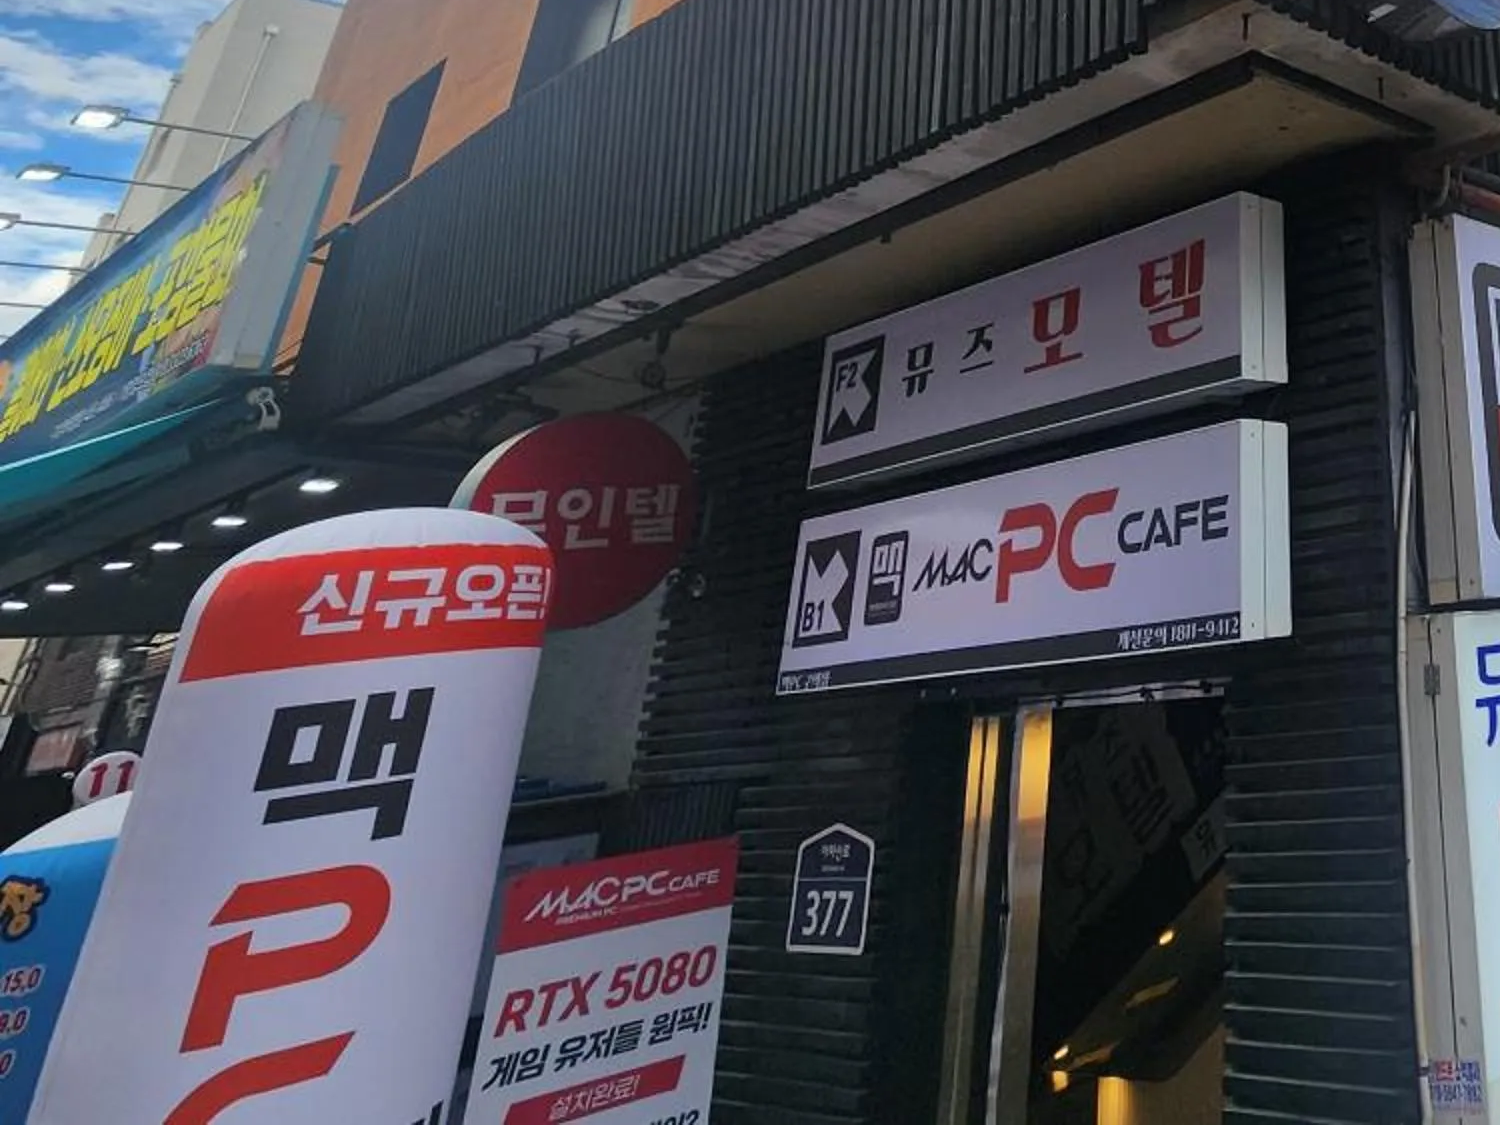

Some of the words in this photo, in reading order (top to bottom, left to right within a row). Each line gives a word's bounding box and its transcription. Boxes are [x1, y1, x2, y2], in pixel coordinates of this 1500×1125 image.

[834, 361, 859, 393] F2
[492, 484, 681, 550] 무인텔
[1117, 493, 1230, 554] CAFE
[802, 599, 825, 633] B1
[668, 868, 721, 892] CAFE
[801, 889, 855, 938] 377
[493, 970, 602, 1039] RTX
[603, 944, 718, 1010] 5080
[481, 1043, 549, 1092] 게임
[552, 1019, 645, 1073] 유저들
[648, 1001, 714, 1047] 원픽!
